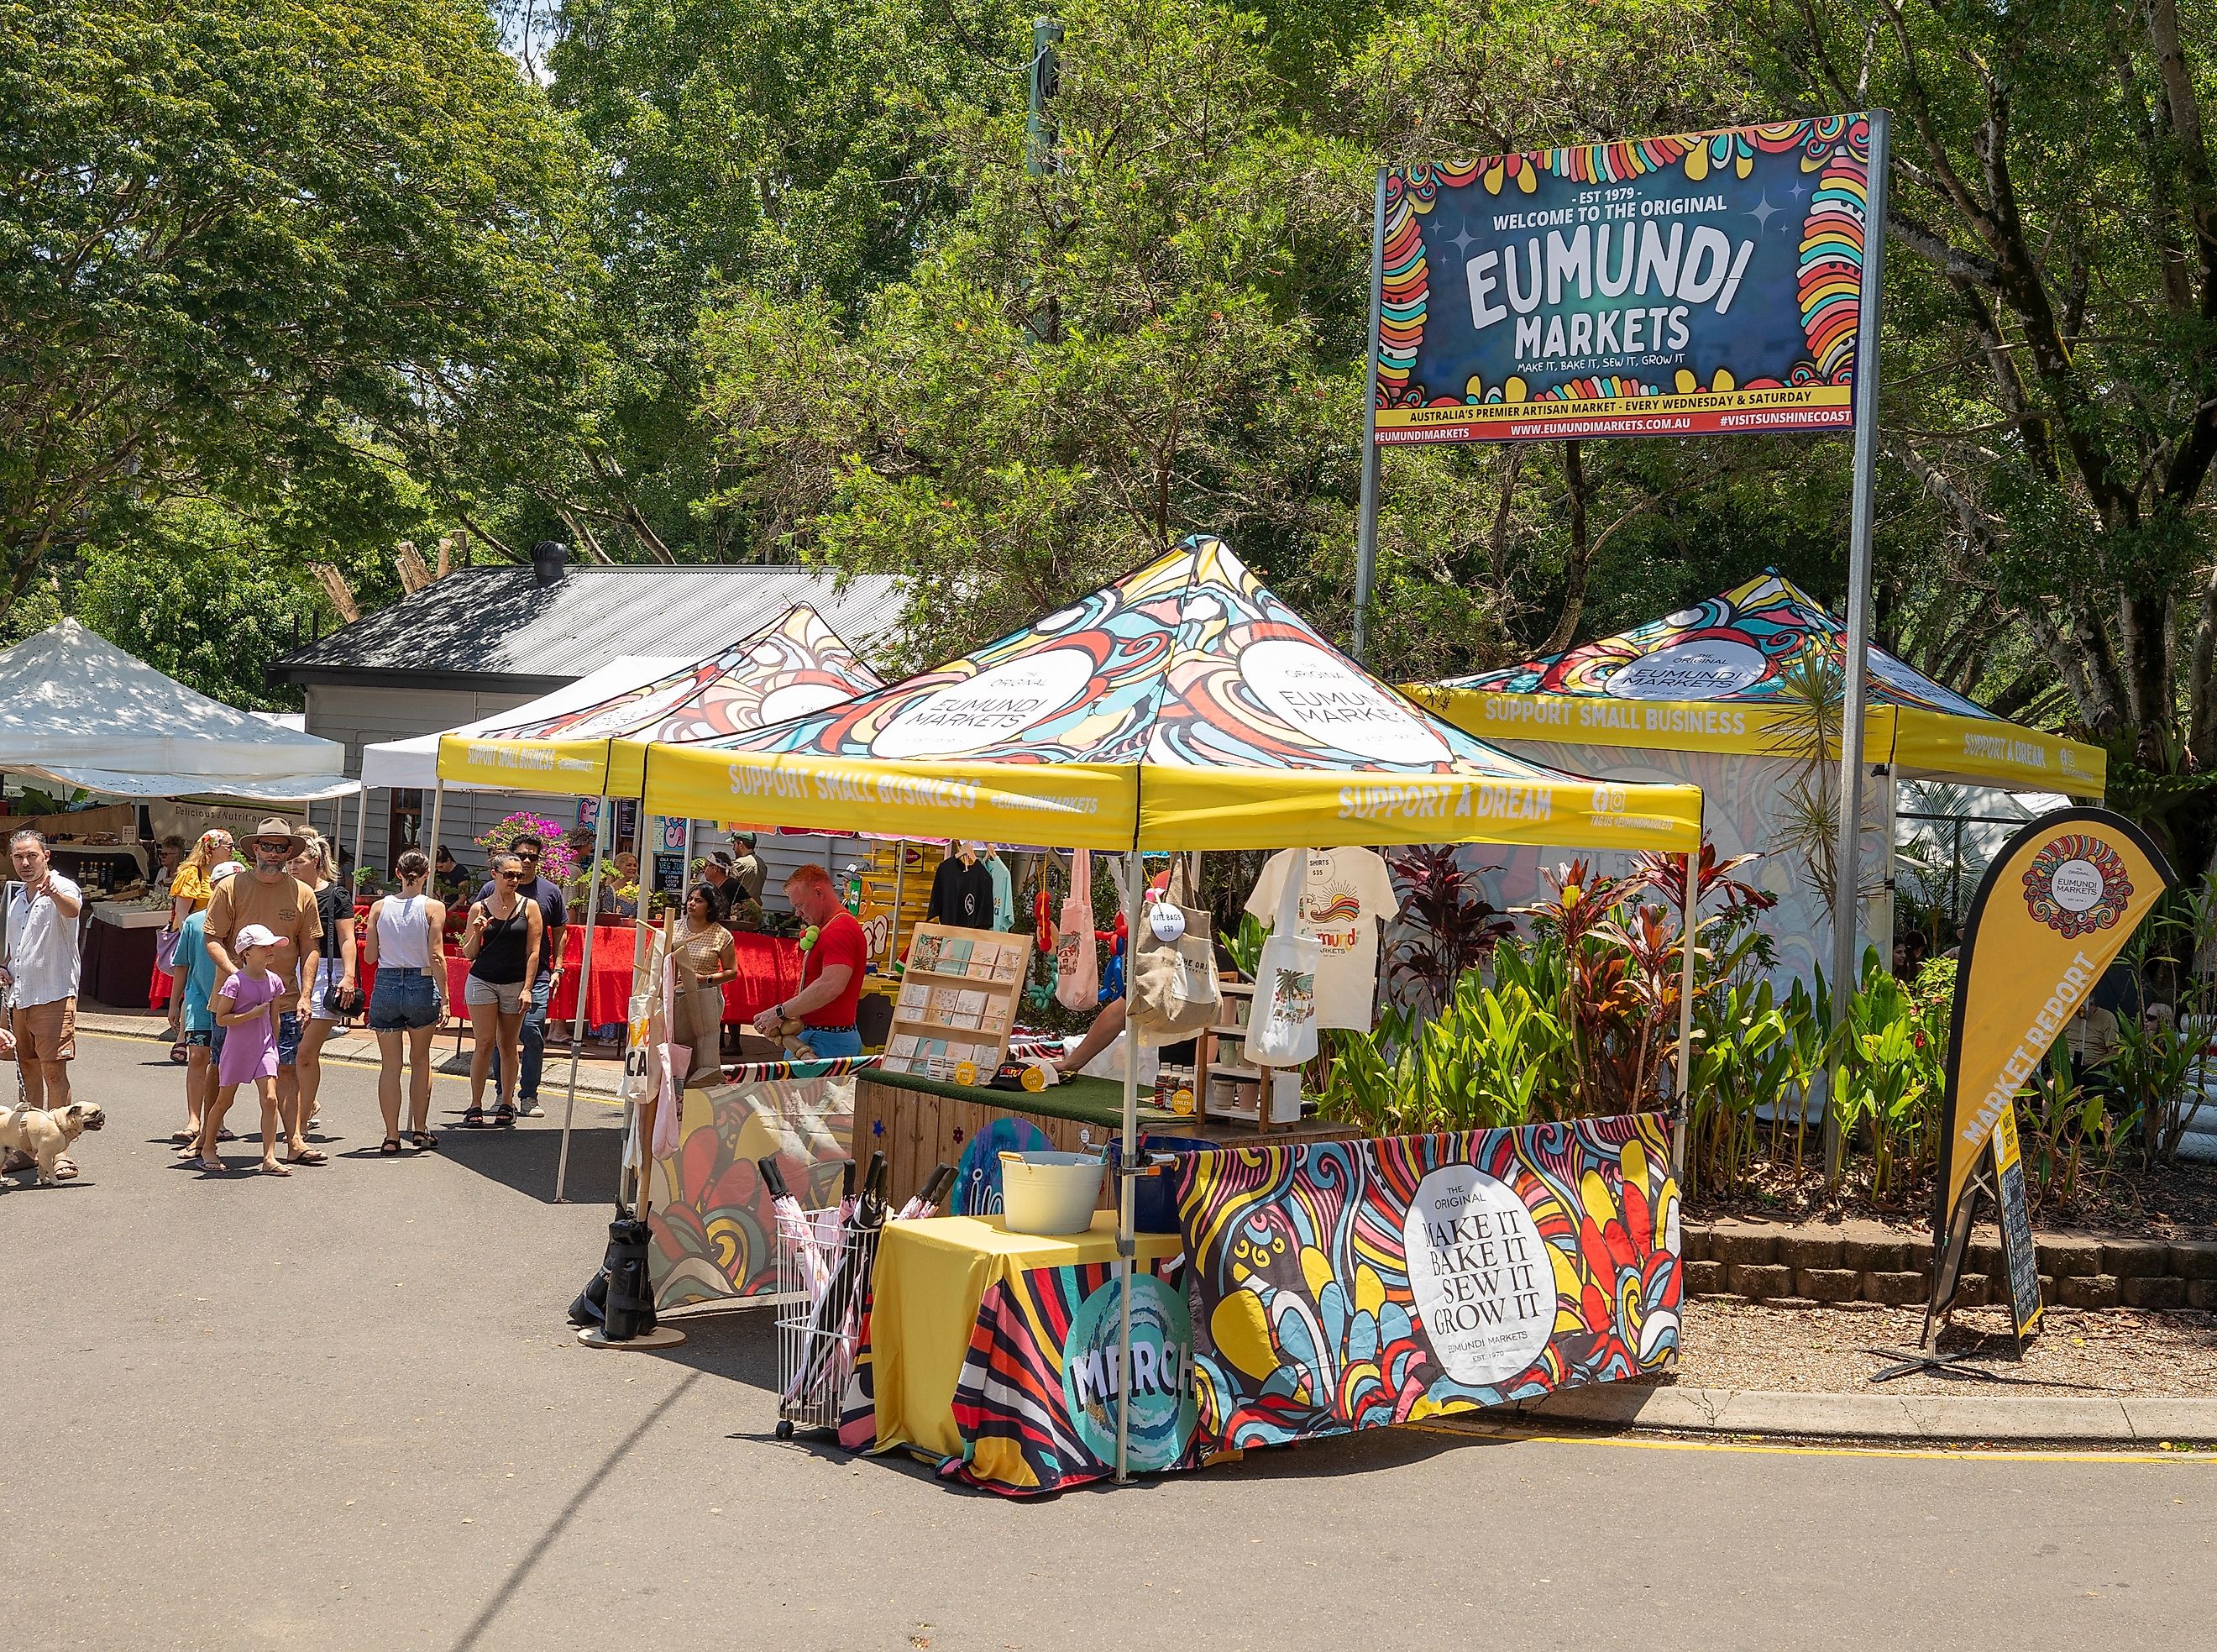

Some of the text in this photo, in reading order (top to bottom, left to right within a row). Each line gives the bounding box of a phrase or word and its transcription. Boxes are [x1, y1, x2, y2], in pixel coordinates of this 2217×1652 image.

[1580, 191, 1601, 204] EST
[1605, 187, 1634, 201] 1979
[1493, 195, 1727, 230] WELCOME TO THE ORIGINAL
[1466, 220, 1754, 329] EUMUNDI
[1515, 306, 1690, 359] MARKETS
[1517, 354, 1685, 373] MAKE IT, BAKE IT, SEW IT, GROW IT
[1476, 406, 1520, 418] PREMIER
[1523, 404, 1569, 416] ARTISAN
[1572, 401, 1616, 413] MARKET
[1626, 399, 1659, 411] EVERY
[1663, 395, 1733, 410] WEDNESDAY
[1737, 396, 1745, 404] &
[1749, 391, 1812, 404] SATURDAY
[1511, 418, 1690, 435] WWW.EUMUNDIMARKETS.COM.AU
[1720, 410, 1851, 426] #VISITSUNSHINECOAST
[1375, 427, 1470, 442] #EUMUNDIMARKETS
[1622, 678, 1736, 688] MARKETS
[1633, 669, 1743, 679] EUMUNDI
[930, 699, 1048, 712] EUMUNDI
[905, 713, 1025, 728] MARKETS
[1485, 699, 1572, 726] SUPPORT
[1580, 705, 1640, 729] SMALL
[1646, 709, 1746, 735] BUSINESS
[467, 743, 498, 767] SUPPORT
[499, 745, 519, 769] SMALL
[520, 747, 555, 771] BUSINESS
[1963, 733, 2047, 768] SUPPORT A DREAM
[729, 764, 981, 810] SUPPORT SMALL BUSINESS
[176, 805, 214, 818] Delicious
[1338, 784, 1552, 821] SUPPORT A DREAM
[1591, 815, 1604, 826] TAG
[1605, 816, 1613, 826] US
[2057, 886, 2097, 896] MARKETS
[2058, 878, 2097, 889] EUMUNDI
[1962, 1044, 2036, 1146] MARKET
[2024, 950, 2096, 1049] REPORT
[1447, 1185, 1464, 1194] THE
[1434, 1193, 1486, 1209] ORIGINAL
[1422, 1209, 1521, 1247] MAKE IT
[1430, 1236, 1529, 1276] BAKE IT
[1442, 1264, 1534, 1304] SEW IT
[1434, 1292, 1540, 1335] GROW IT
[1448, 1331, 1528, 1354] EUMUNDI MARKETS
